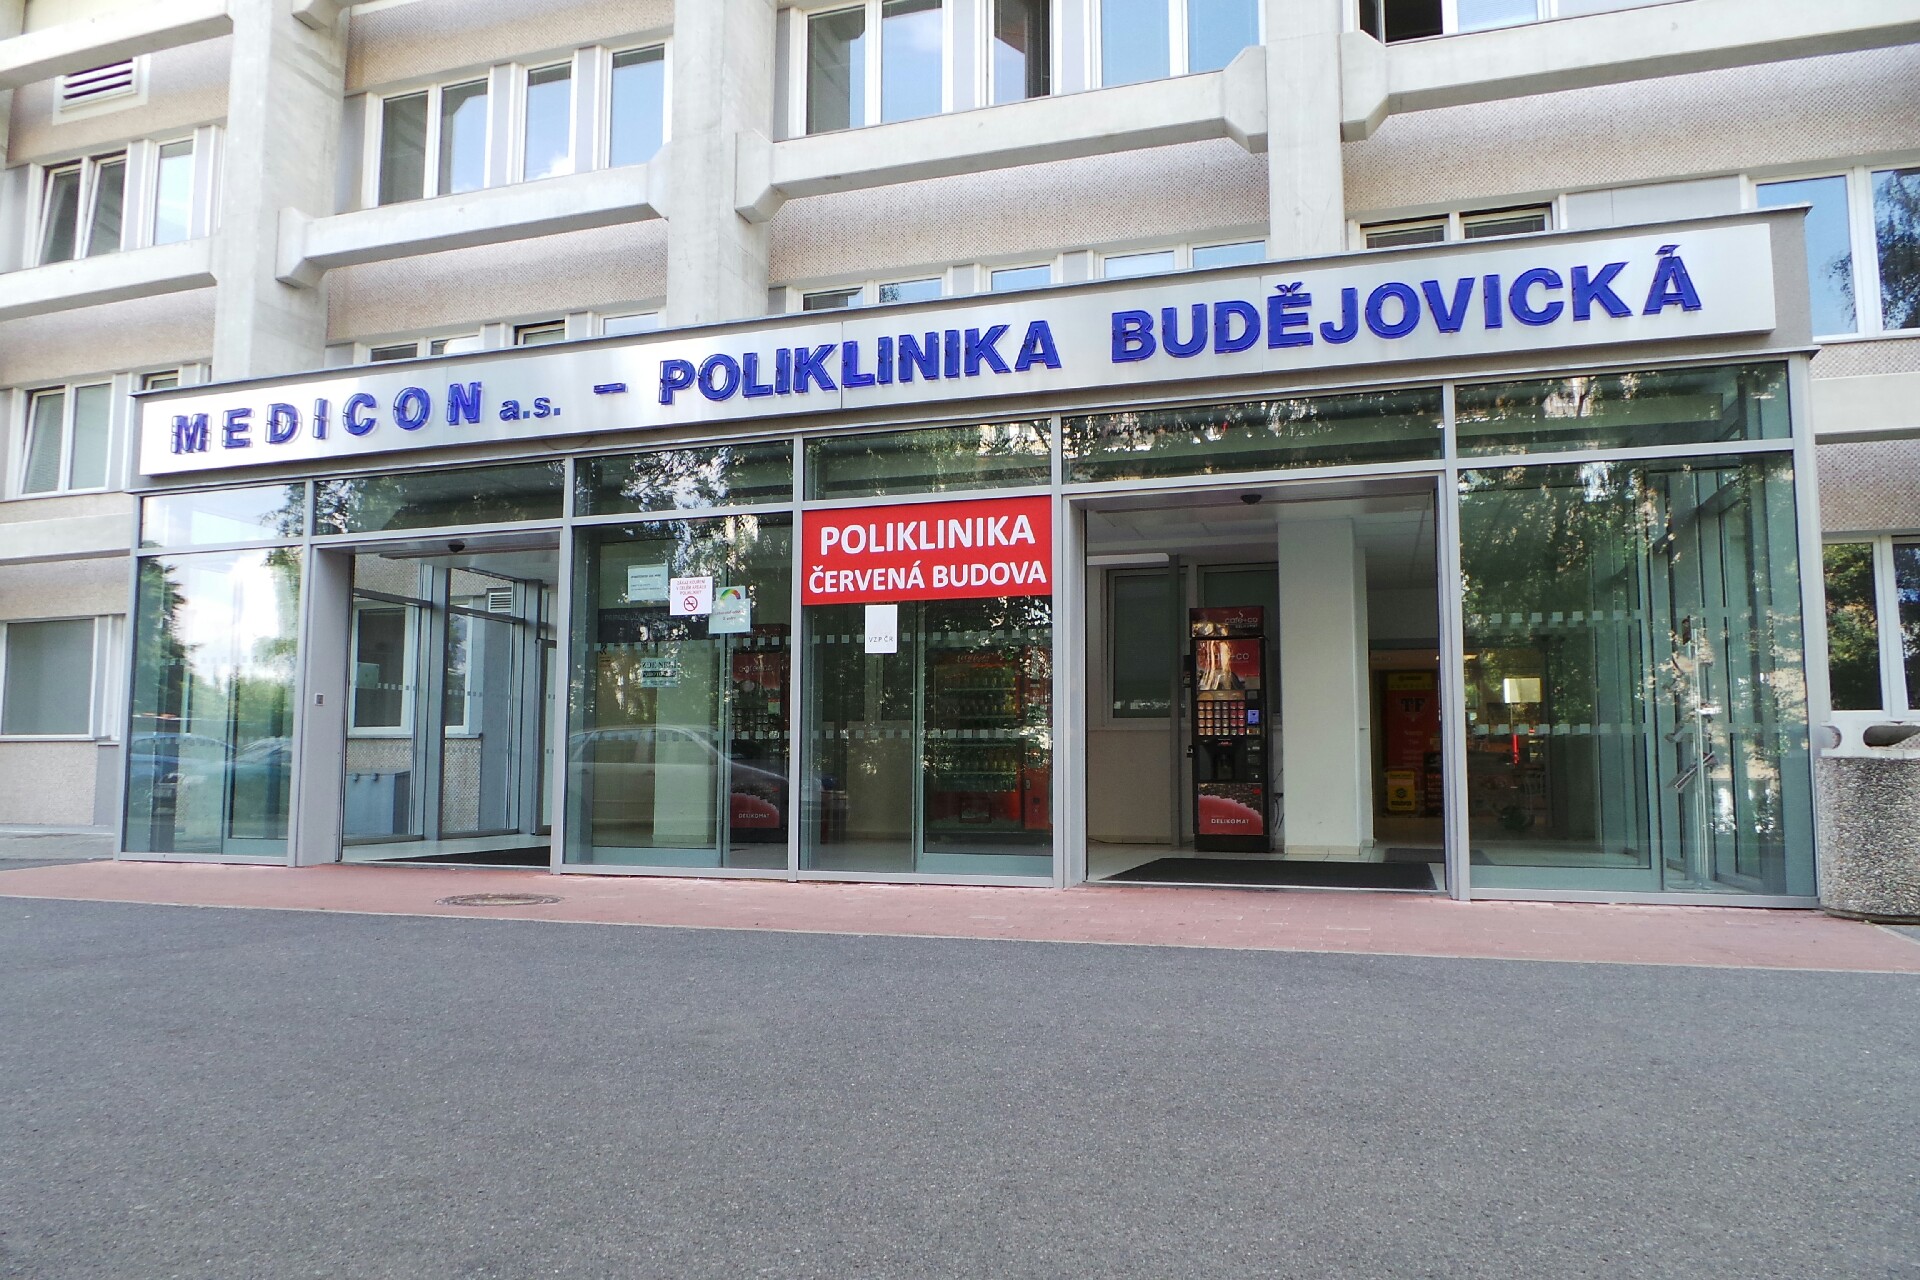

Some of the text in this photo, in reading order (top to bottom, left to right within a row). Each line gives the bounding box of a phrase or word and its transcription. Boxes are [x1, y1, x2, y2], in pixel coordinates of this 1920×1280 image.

[170, 381, 482, 454] MEDICON
[499, 396, 561, 421] a.s.
[658, 320, 1062, 405] POLIKLINIKA
[1111, 244, 1702, 363] BUDĚJOVICKÁ
[820, 514, 1035, 555] POLIKLINIKA
[808, 560, 1047, 593] ČERVENÁ BUDOVA
